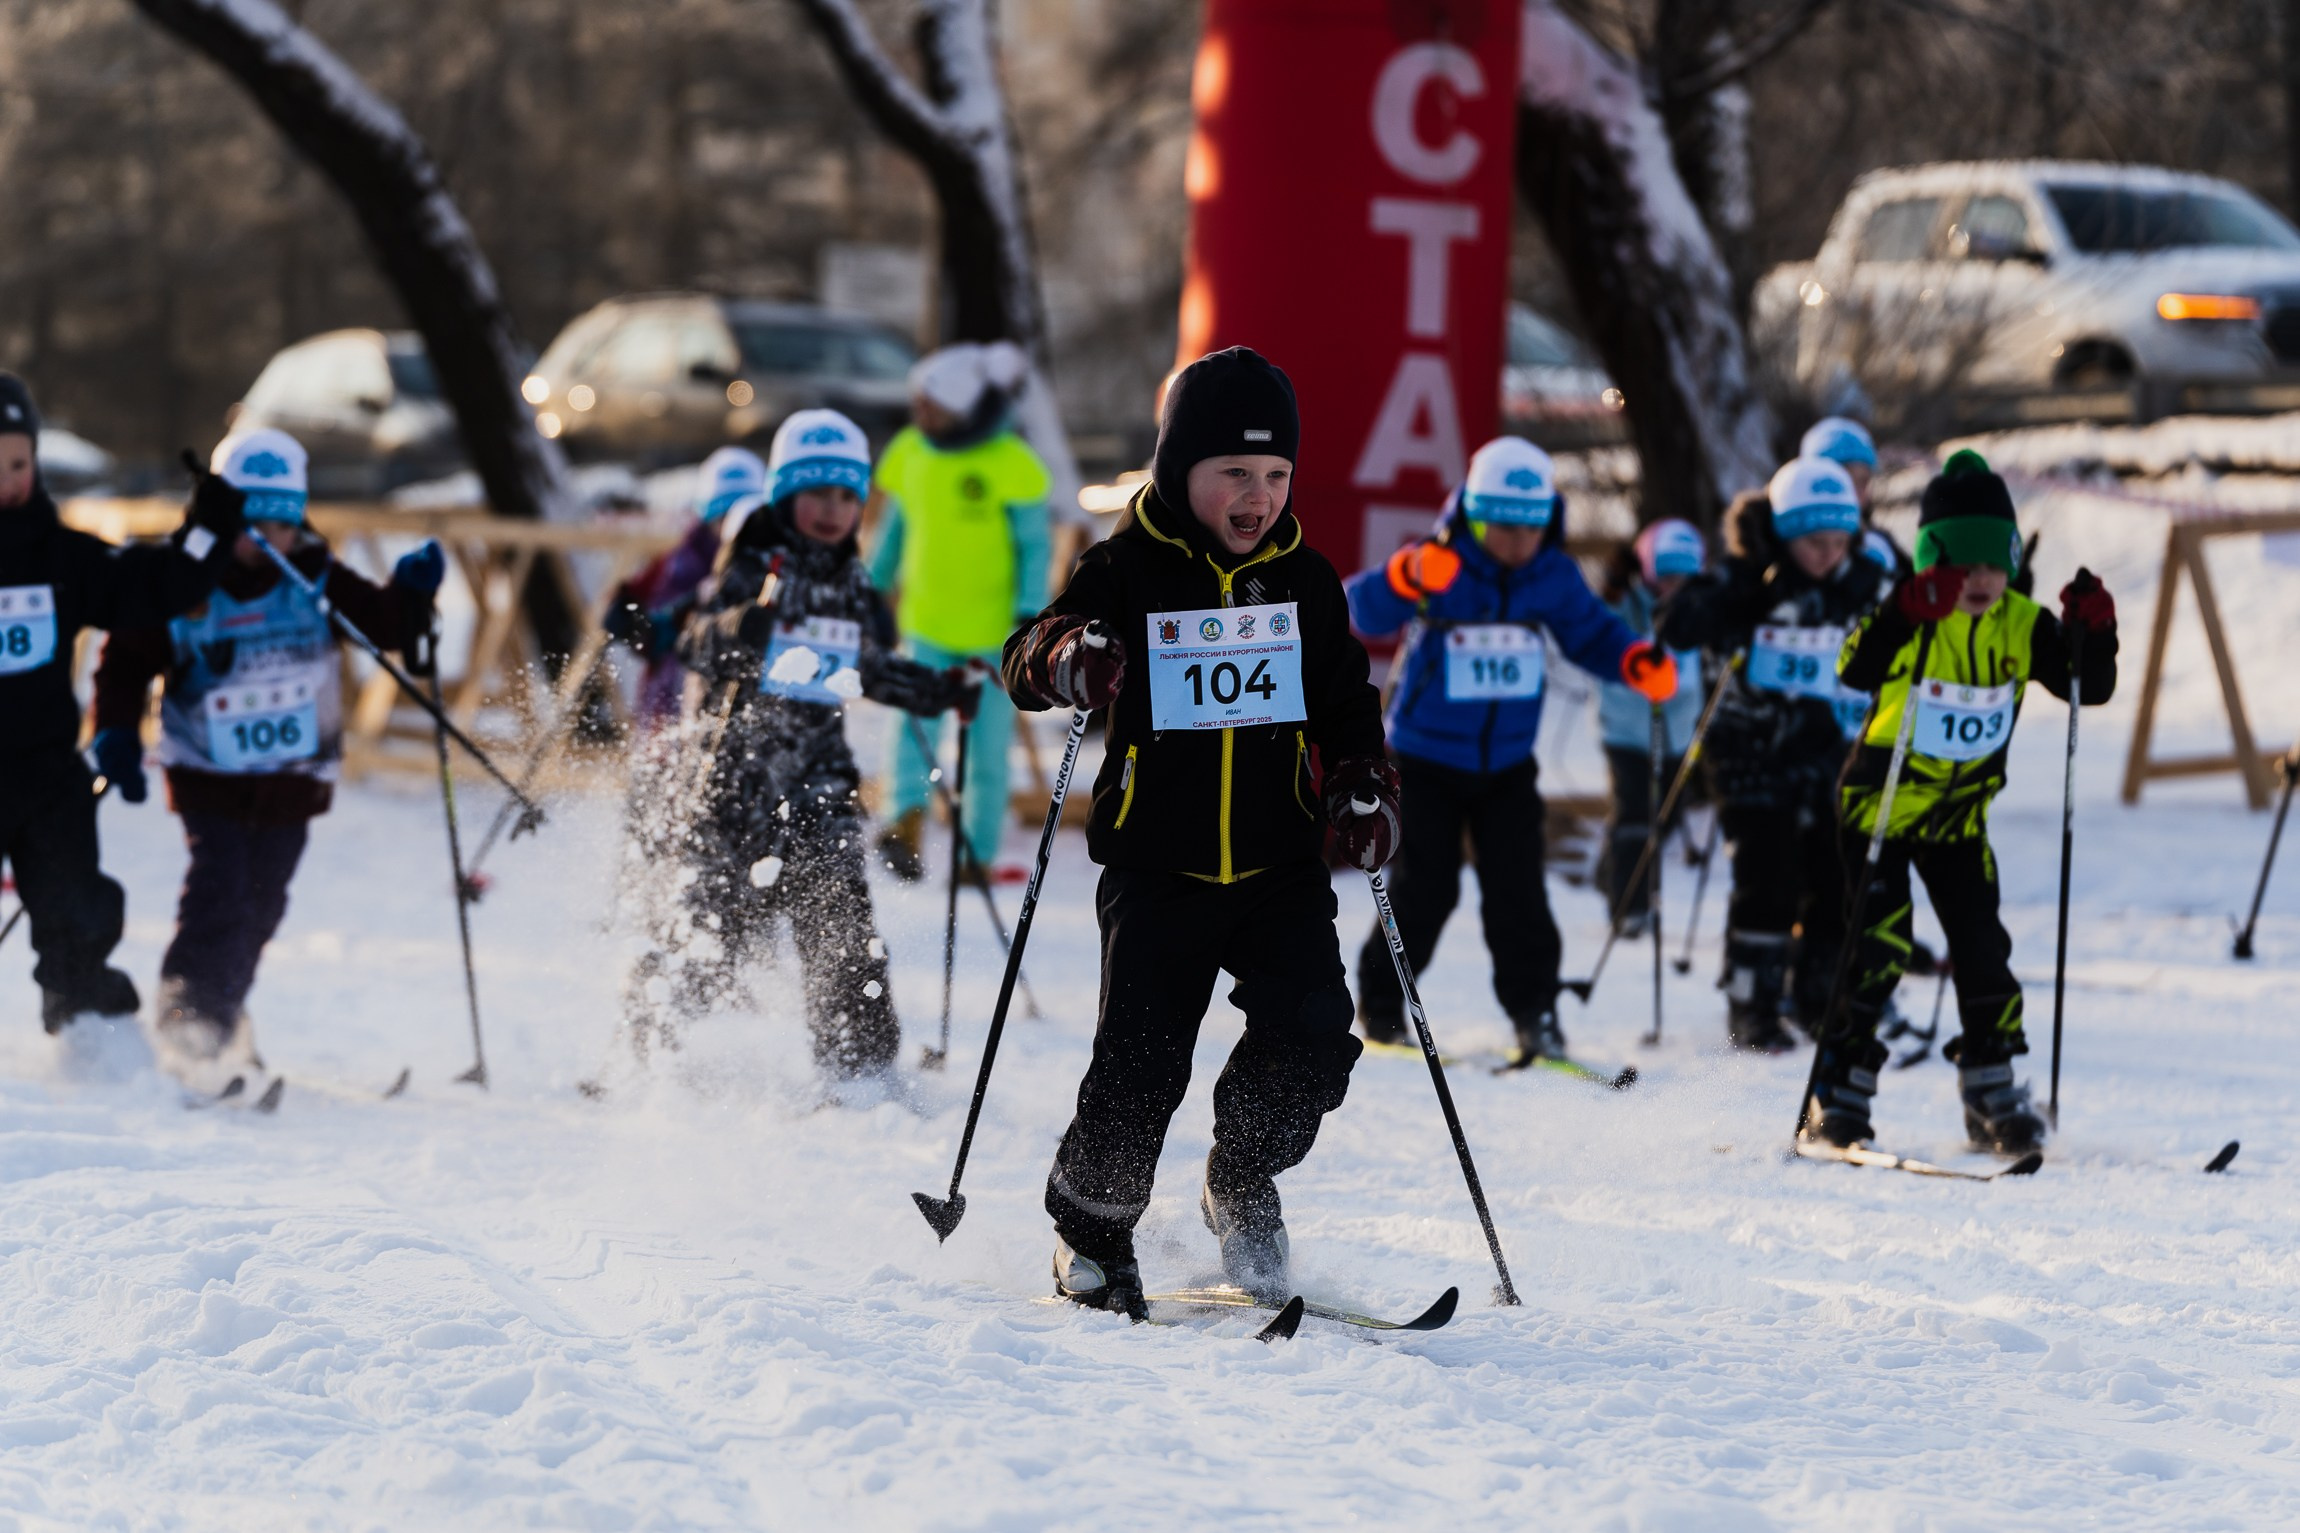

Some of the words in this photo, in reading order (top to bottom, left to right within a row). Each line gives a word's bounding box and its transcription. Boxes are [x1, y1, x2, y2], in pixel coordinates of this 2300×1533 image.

[0, 624, 32, 658] 8
[1160, 652, 1188, 660] ЛЫЖНЯ
[1190, 651, 1221, 659] РОССИИ
[1228, 647, 1270, 657] КУРОРТНОМ
[1185, 660, 1276, 705] 104
[1472, 656, 1521, 687] 116
[233, 715, 302, 752] 106
[1193, 717, 1256, 728] САНКТ-ПЕТЕРБУРГ
[1941, 711, 2003, 744] 103
[1053, 735, 1077, 800] NORDWAY
[1379, 895, 1403, 950] NOWAY
[1421, 1023, 1431, 1044] ACTIVE
[1427, 1043, 1437, 1057] XC
